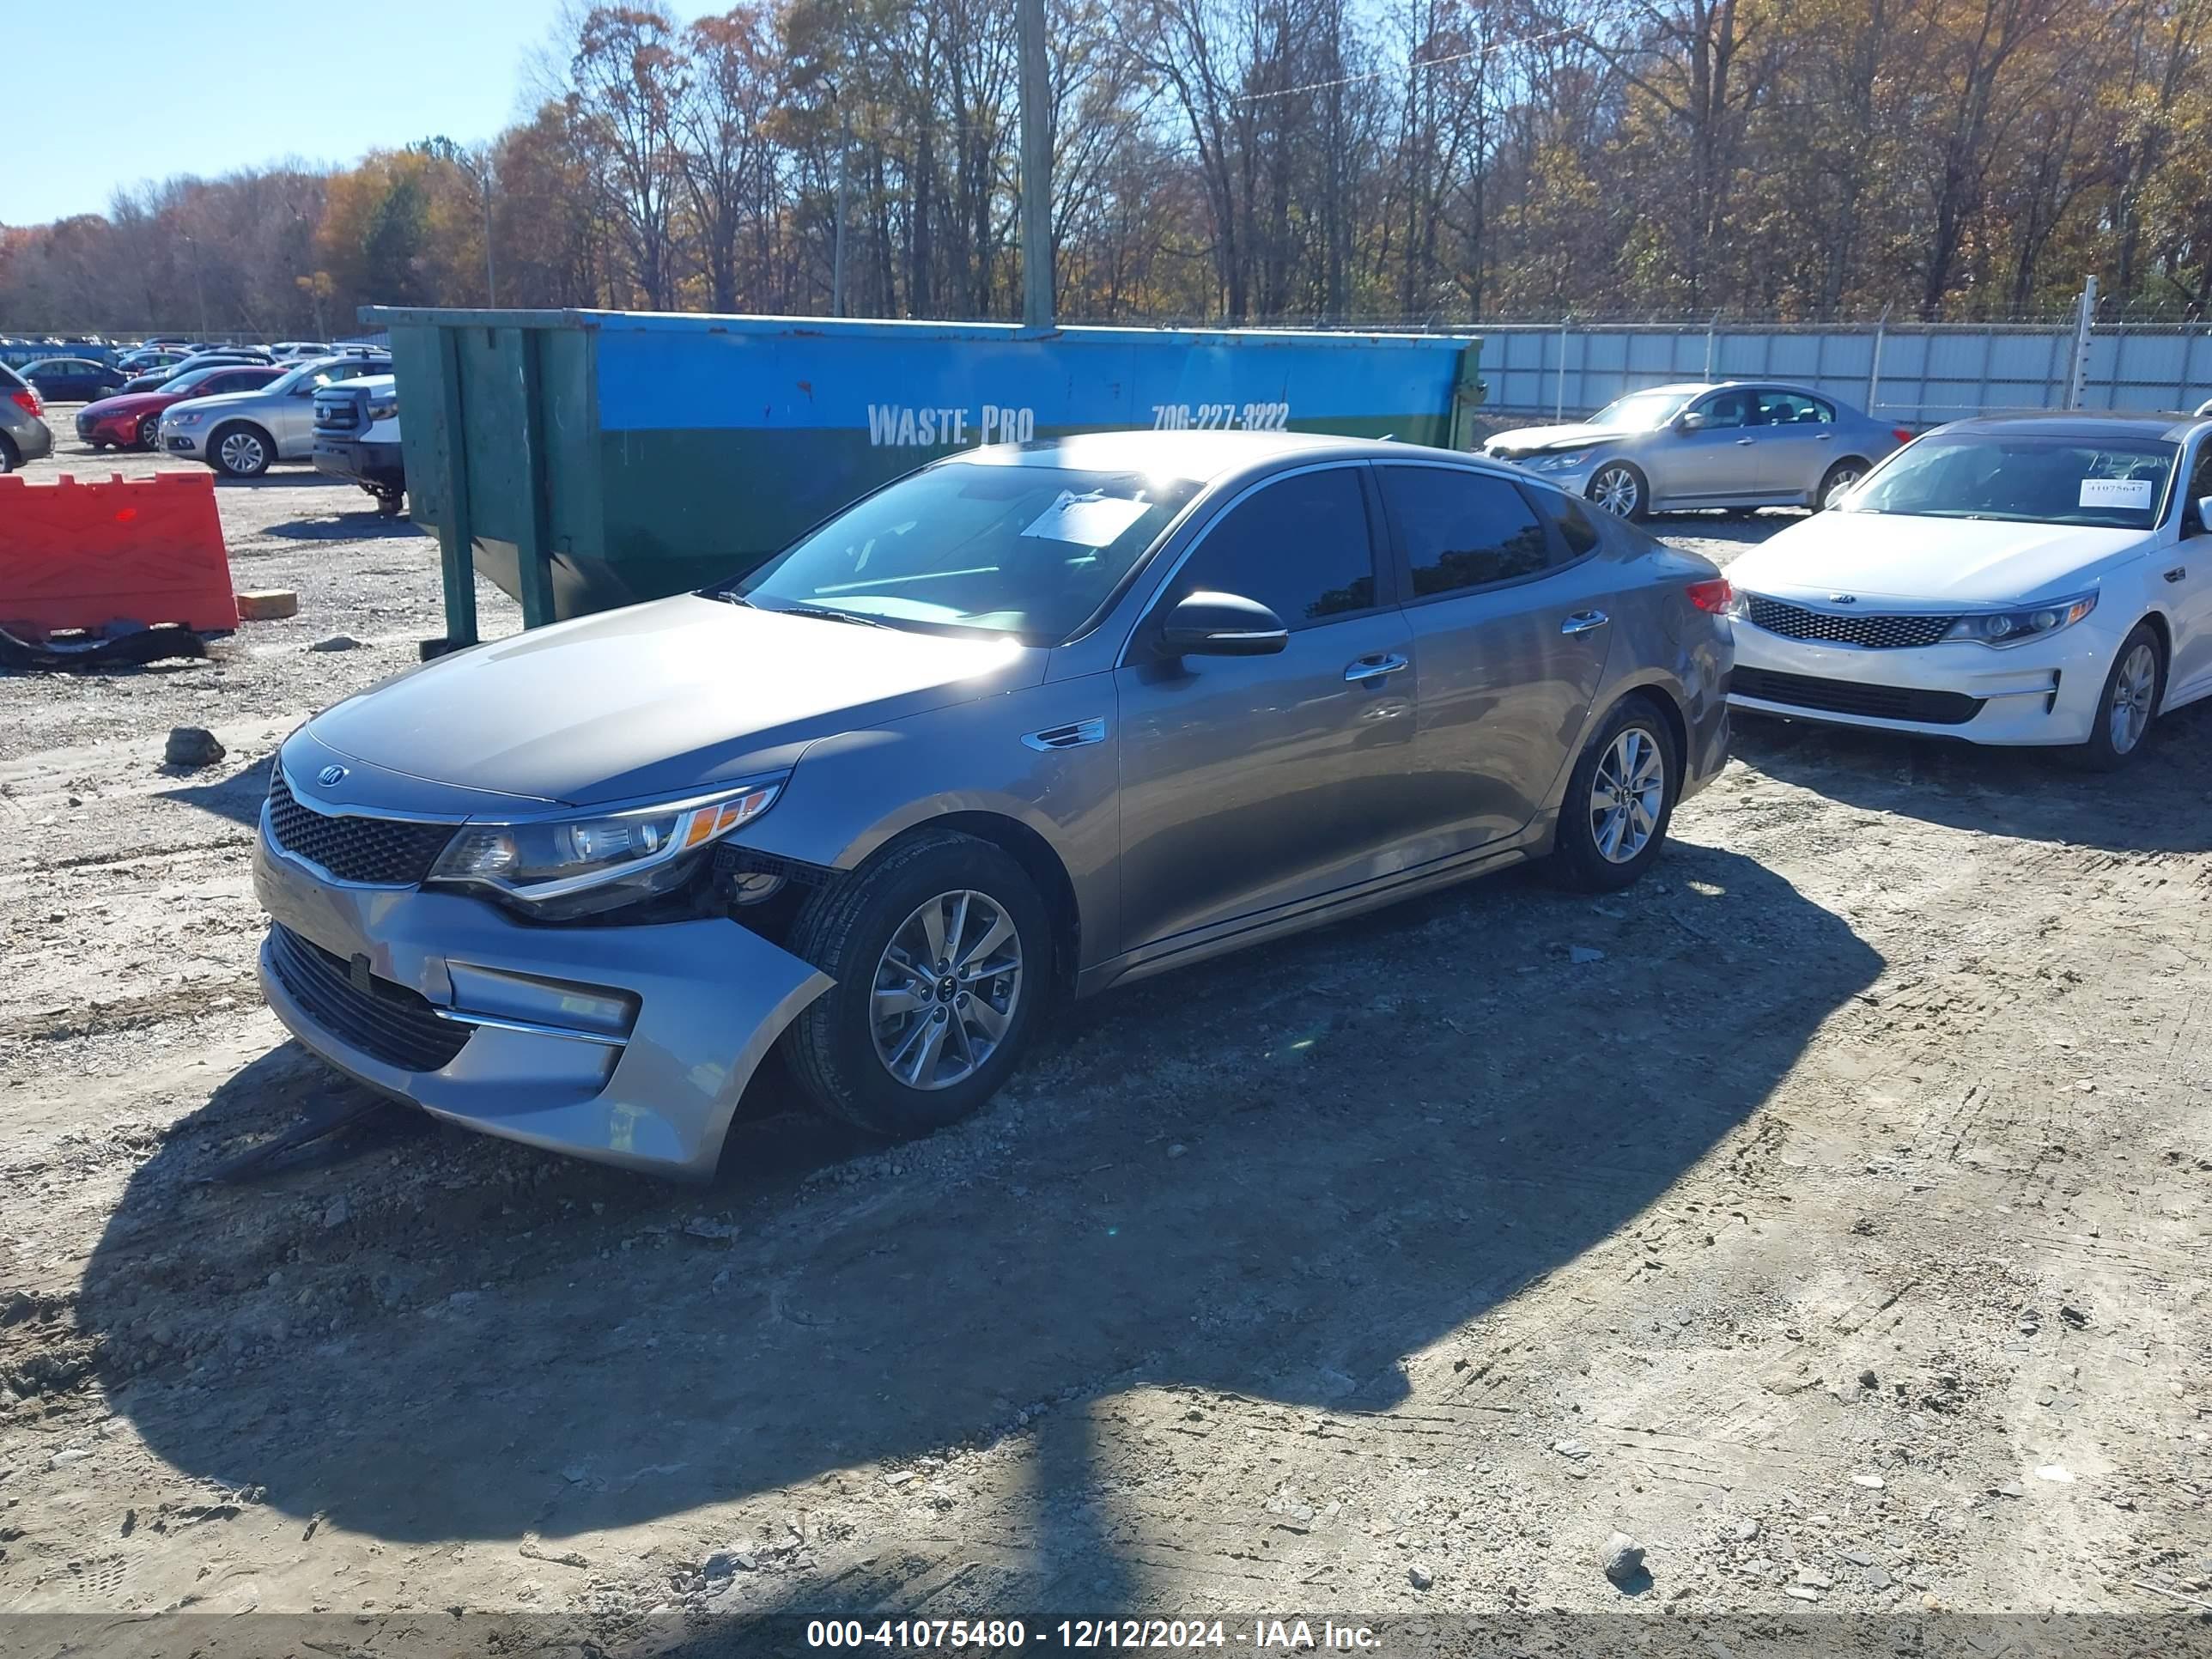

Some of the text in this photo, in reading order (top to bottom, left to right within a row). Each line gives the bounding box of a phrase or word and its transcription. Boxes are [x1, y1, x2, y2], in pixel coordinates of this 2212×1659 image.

[867, 404, 1035, 447] WASTE PRO
[1152, 403, 1289, 432] 706-227-3222
[319, 766, 341, 783] KIA
